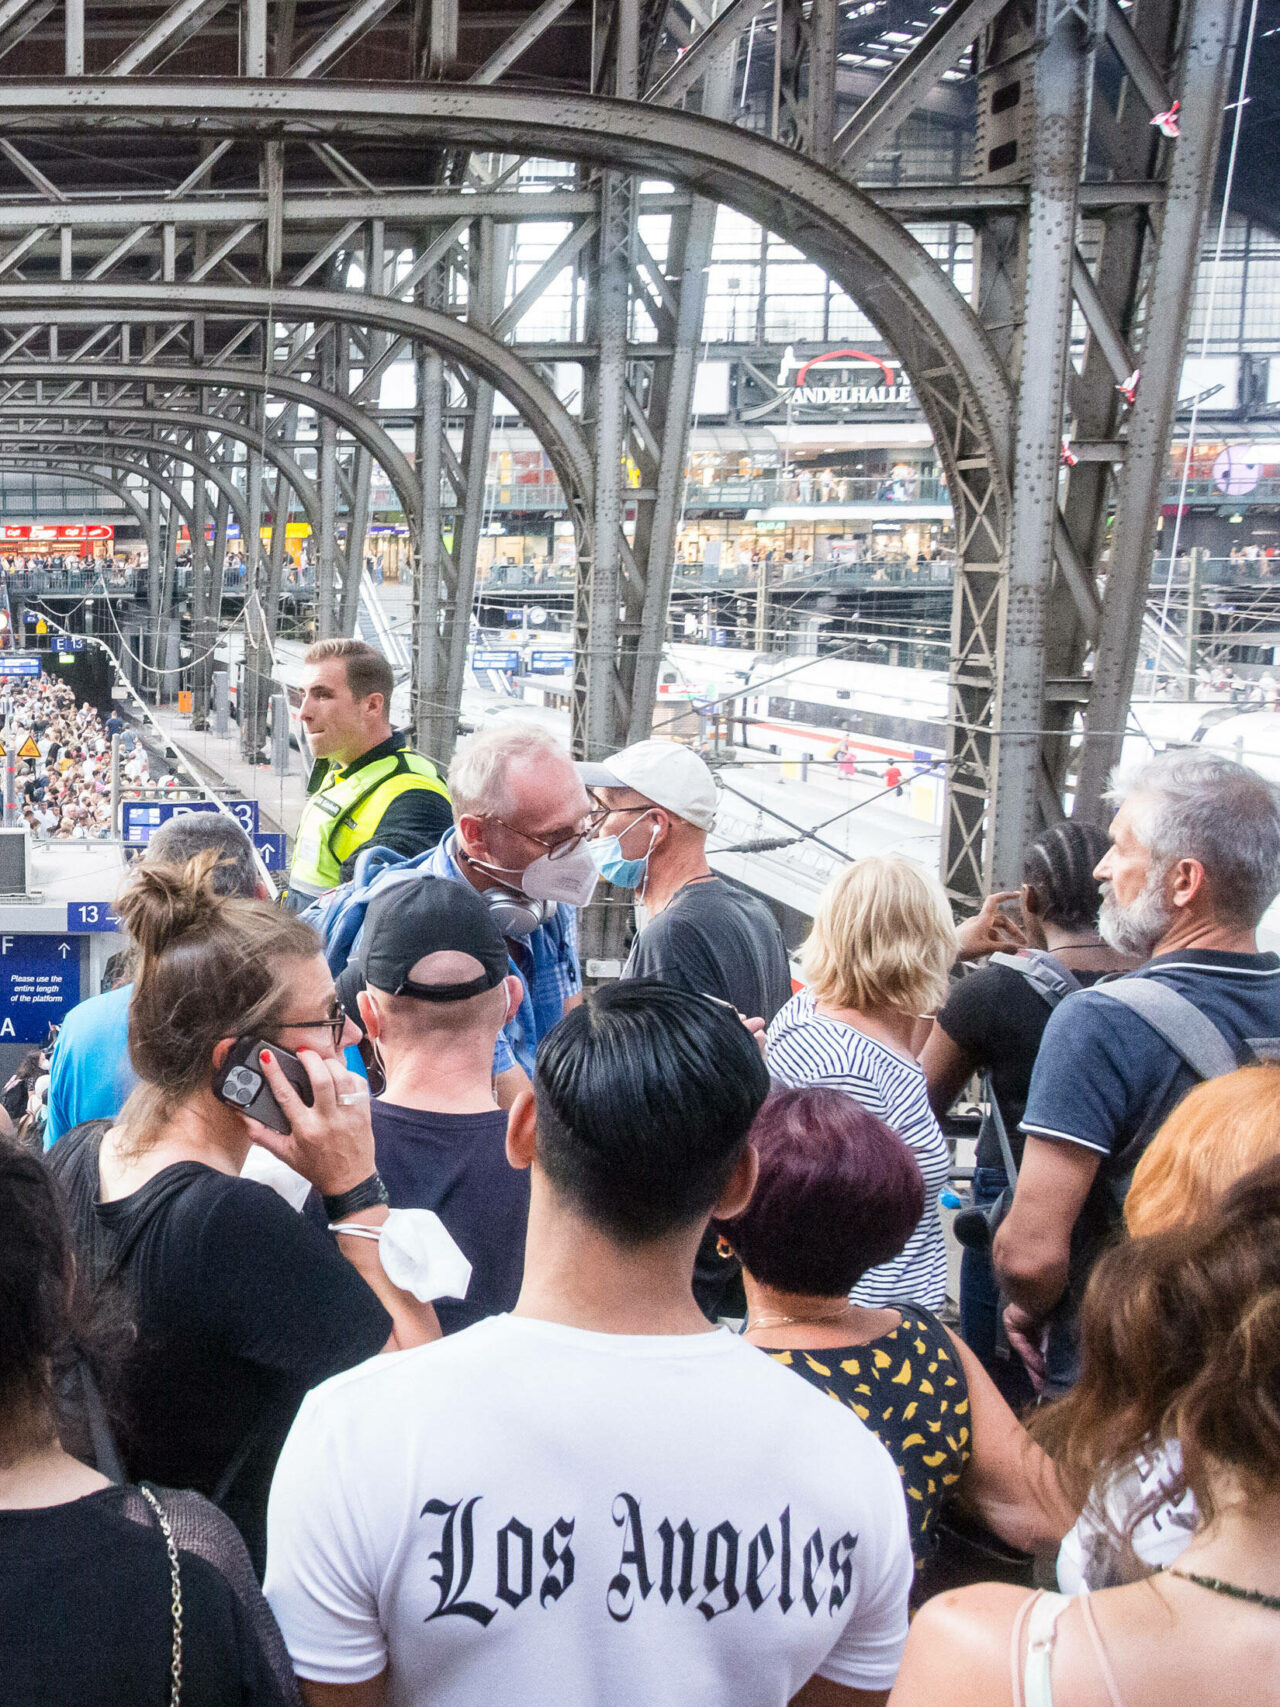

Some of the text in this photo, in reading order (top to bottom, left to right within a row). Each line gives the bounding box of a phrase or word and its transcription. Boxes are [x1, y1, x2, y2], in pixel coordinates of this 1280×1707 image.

[56, 638, 84, 650] E 13
[78, 905, 99, 923] 13
[1, 936, 15, 955] F
[36, 985, 60, 993] length
[32, 995, 63, 1003] platform
[0, 1018, 16, 1037] A
[419, 1491, 860, 1628] Los Angeles
